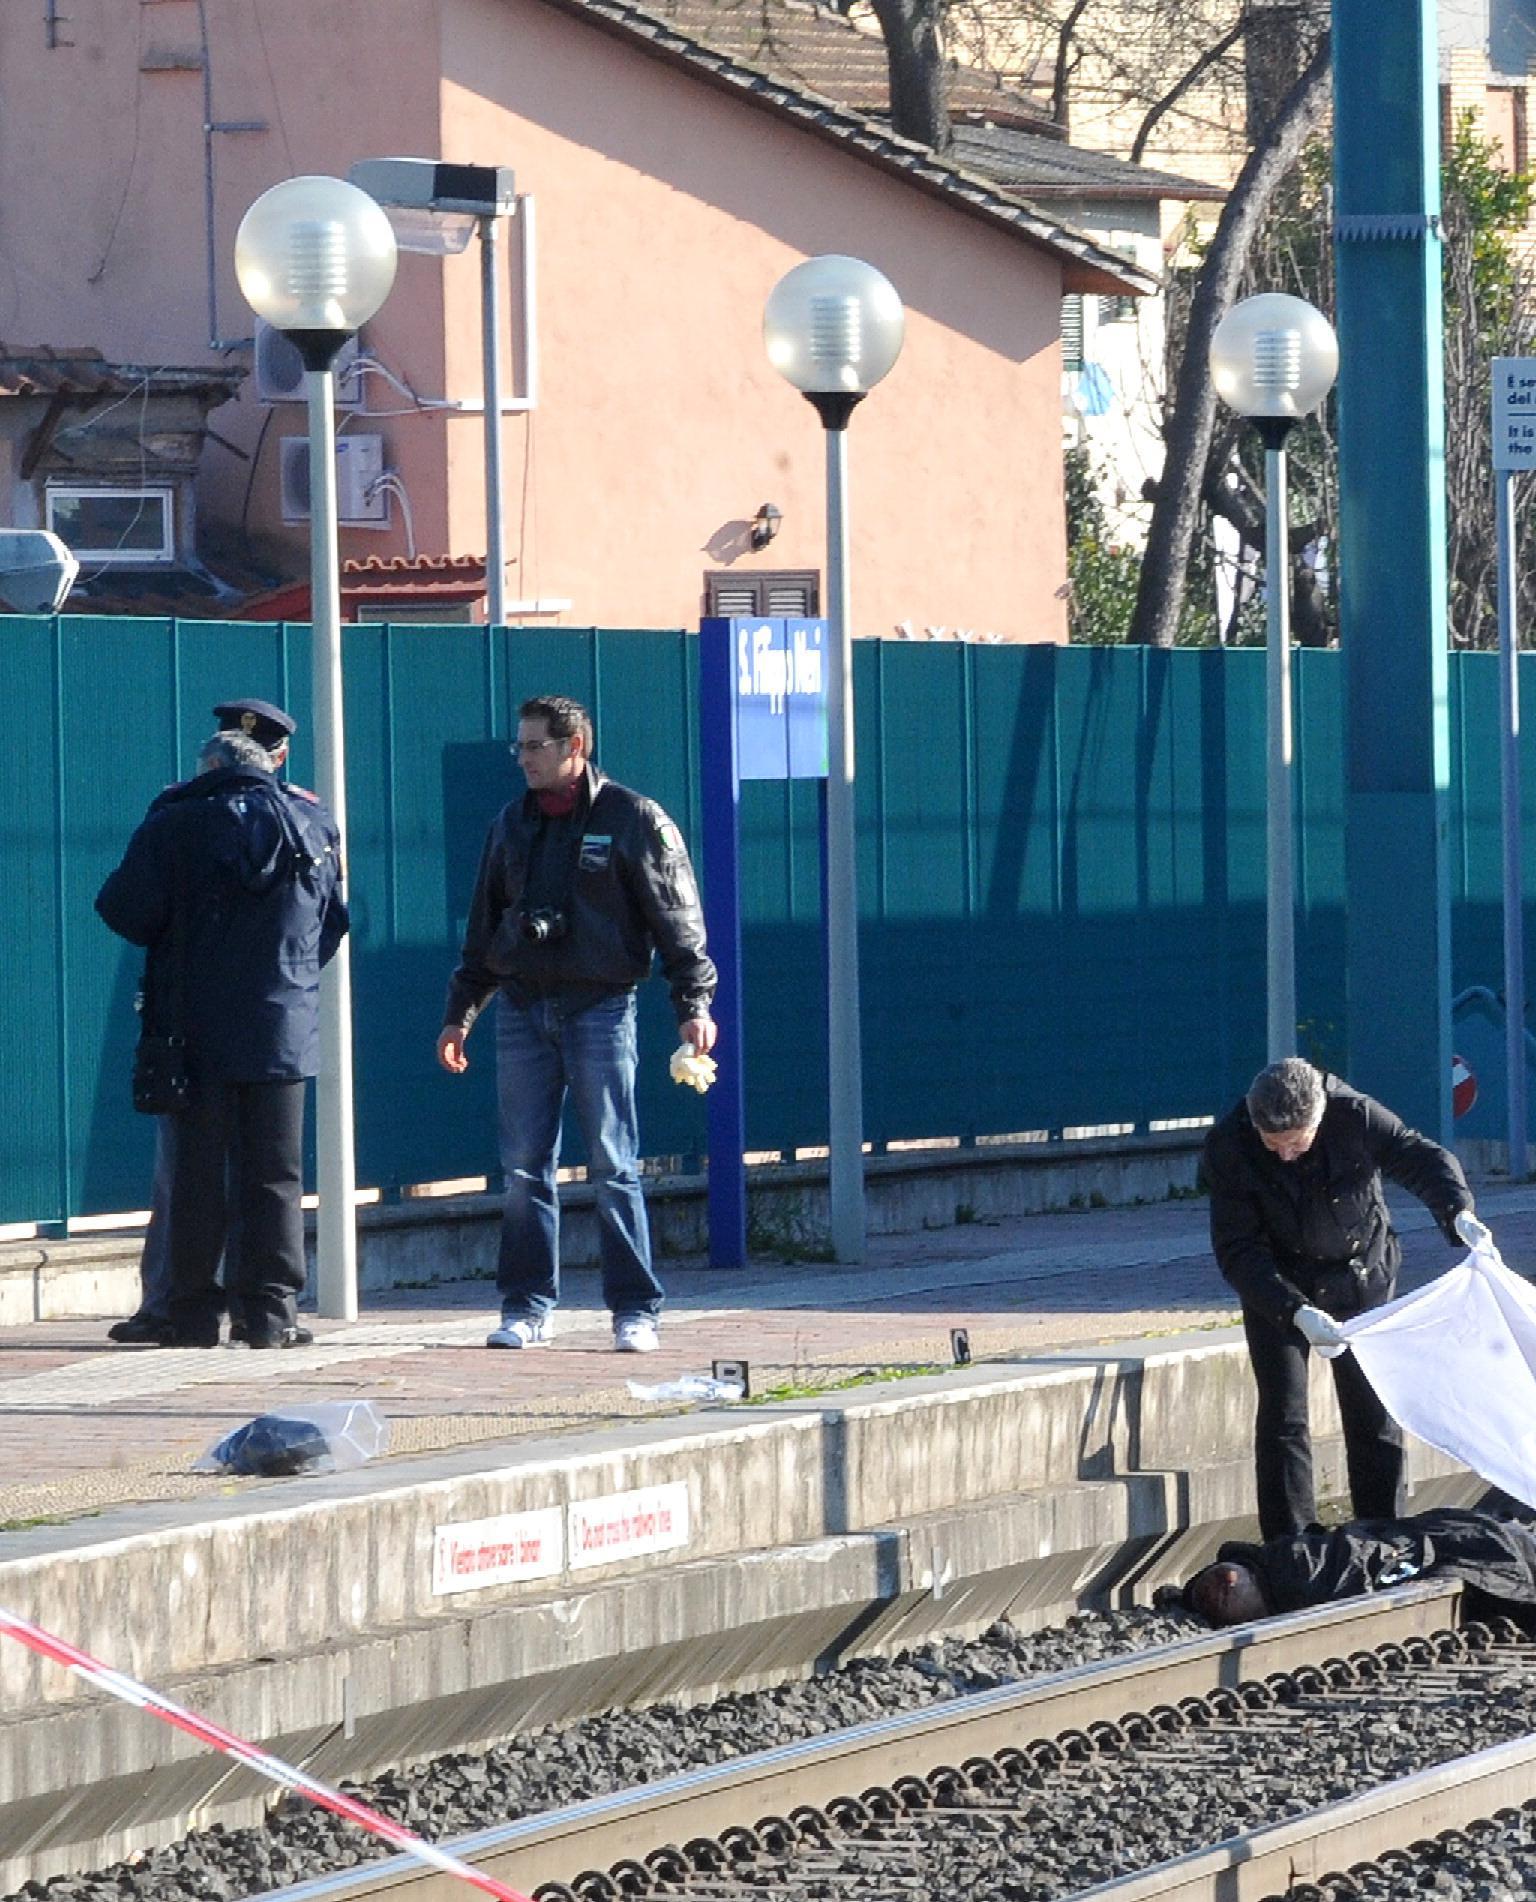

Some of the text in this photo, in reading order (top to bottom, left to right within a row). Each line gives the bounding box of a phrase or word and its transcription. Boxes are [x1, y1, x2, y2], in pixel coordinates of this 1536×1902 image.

[1507, 391, 1531, 405] del
[1508, 425, 1519, 438] It
[1522, 425, 1534, 438] is
[1508, 441, 1532, 454] the
